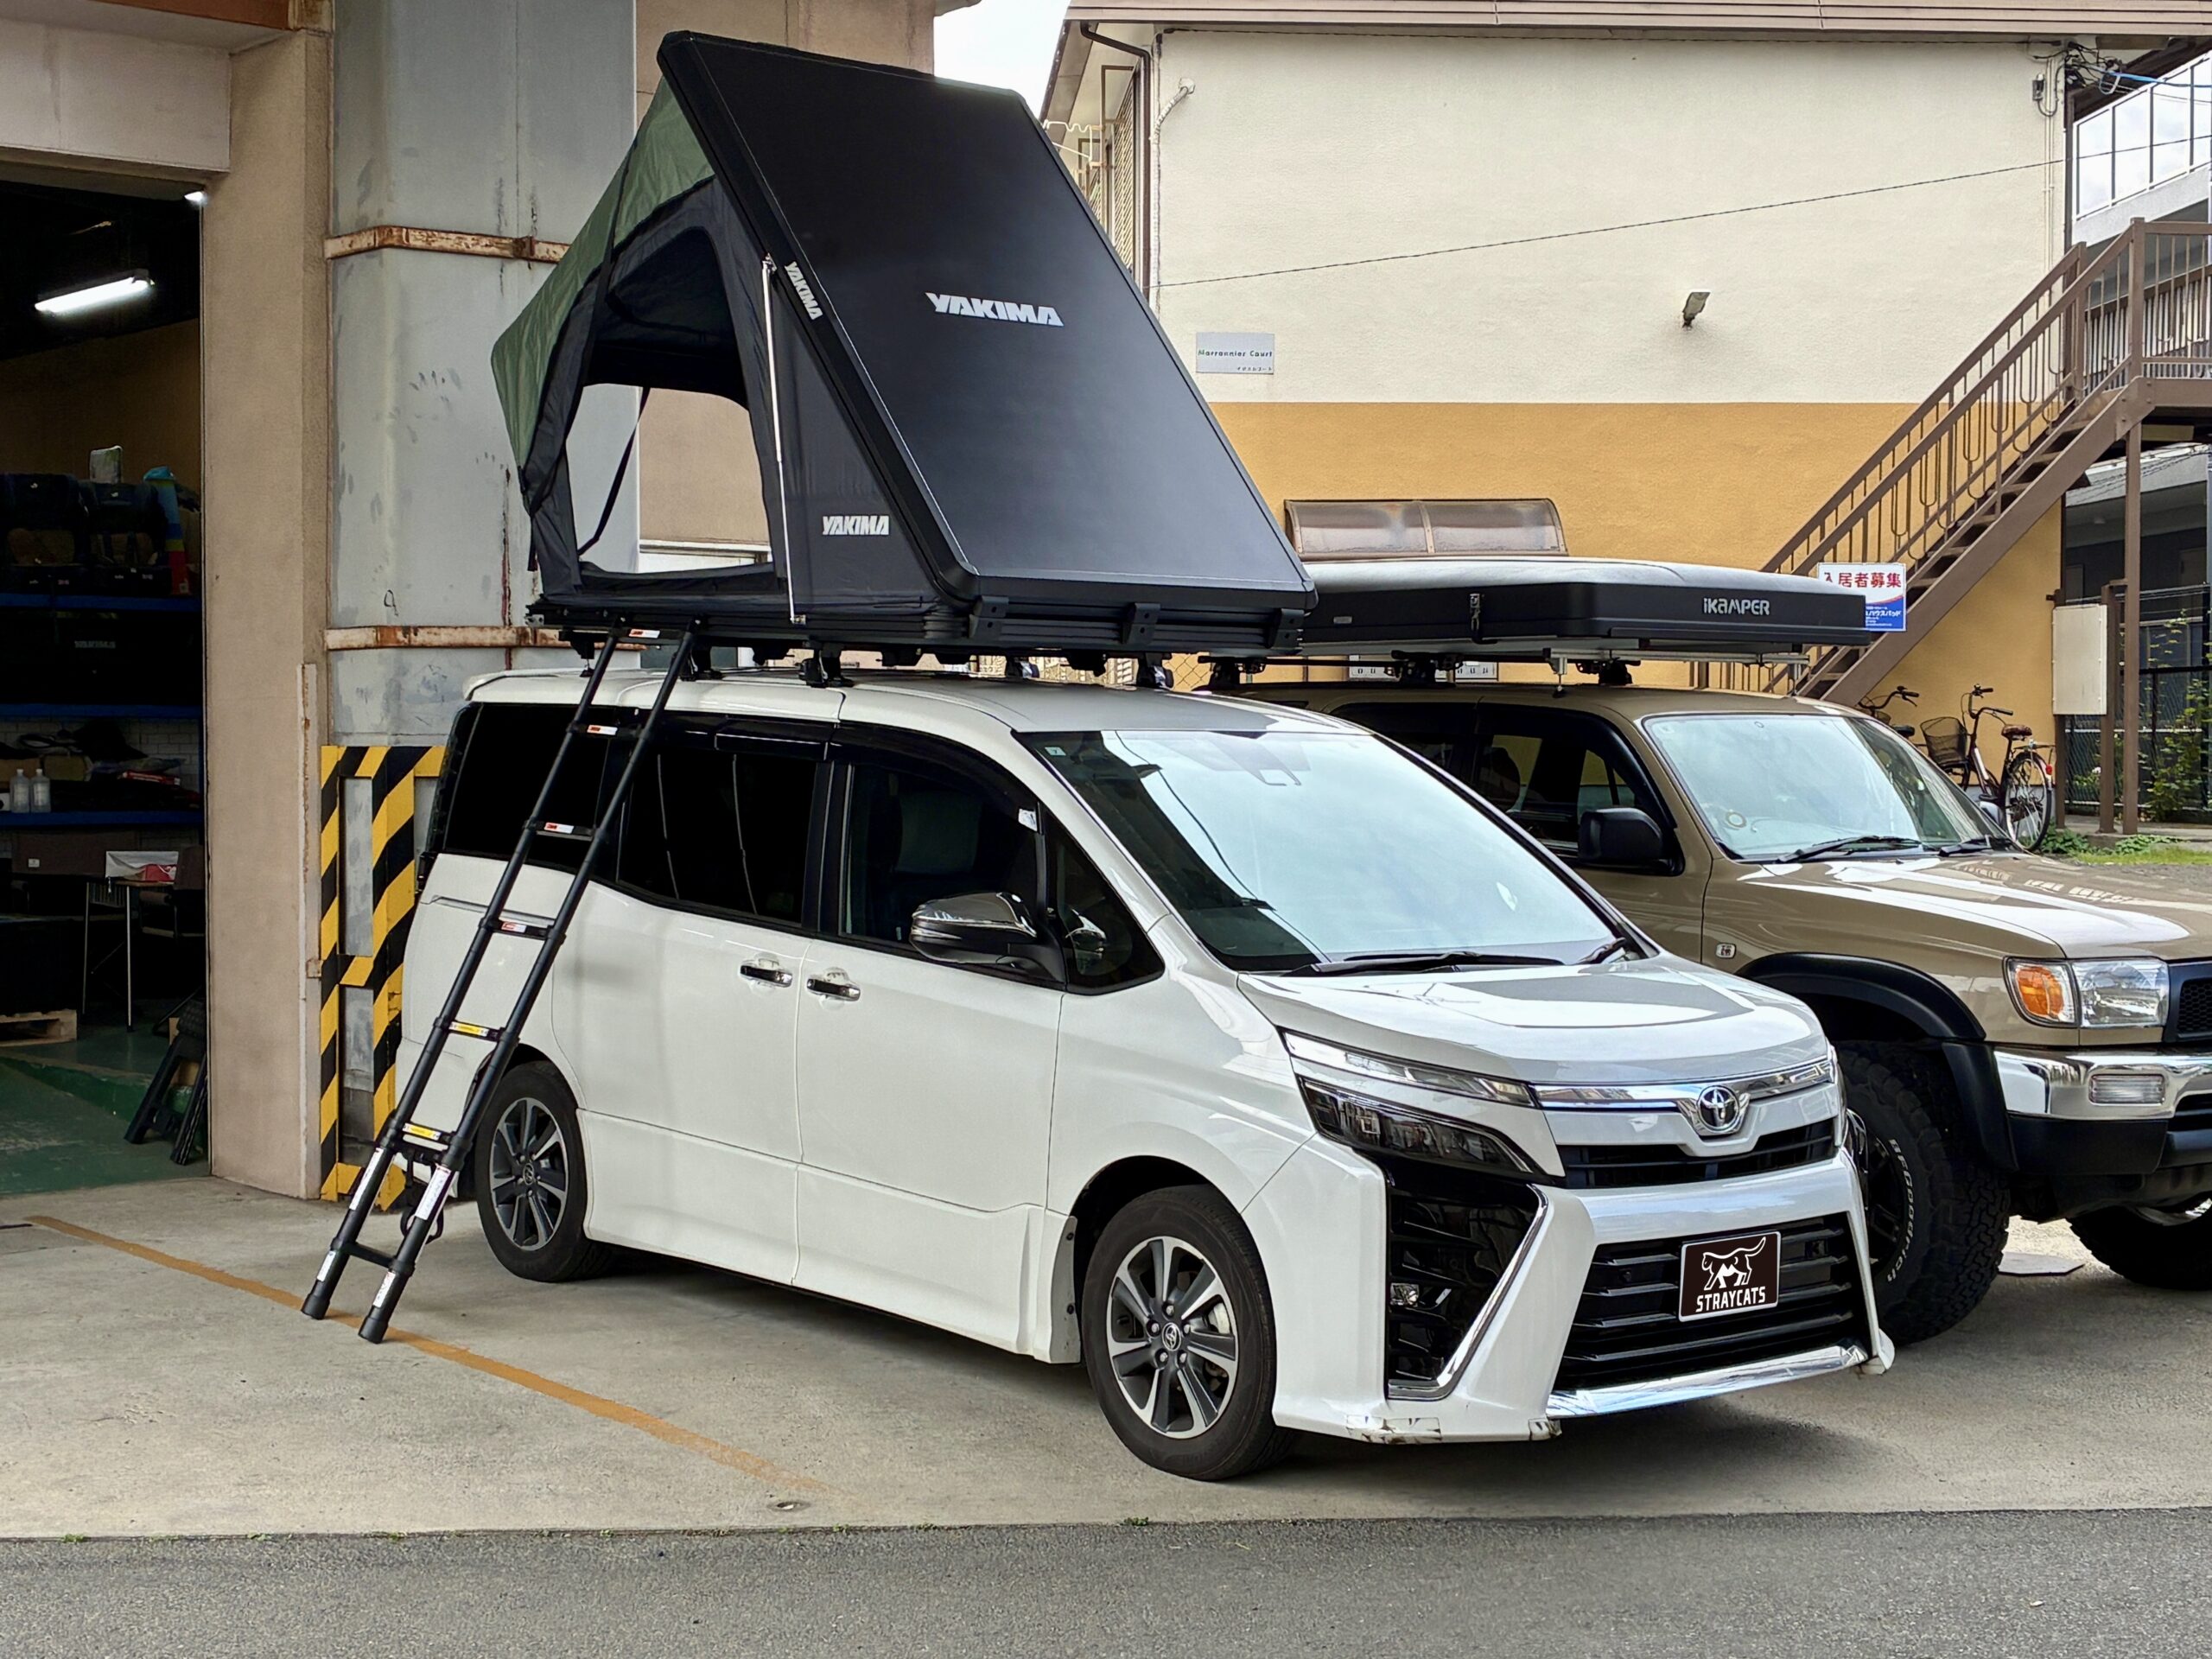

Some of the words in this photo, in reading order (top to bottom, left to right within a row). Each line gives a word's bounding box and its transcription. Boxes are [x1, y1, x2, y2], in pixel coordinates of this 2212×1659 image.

[784, 261, 823, 321] YAKIMA
[925, 292, 1065, 327] YAKIMA
[822, 515, 890, 536] YAKIMA
[1824, 571, 1902, 588] 入居者募集
[1695, 1286, 1766, 1313] STRAYCATS
